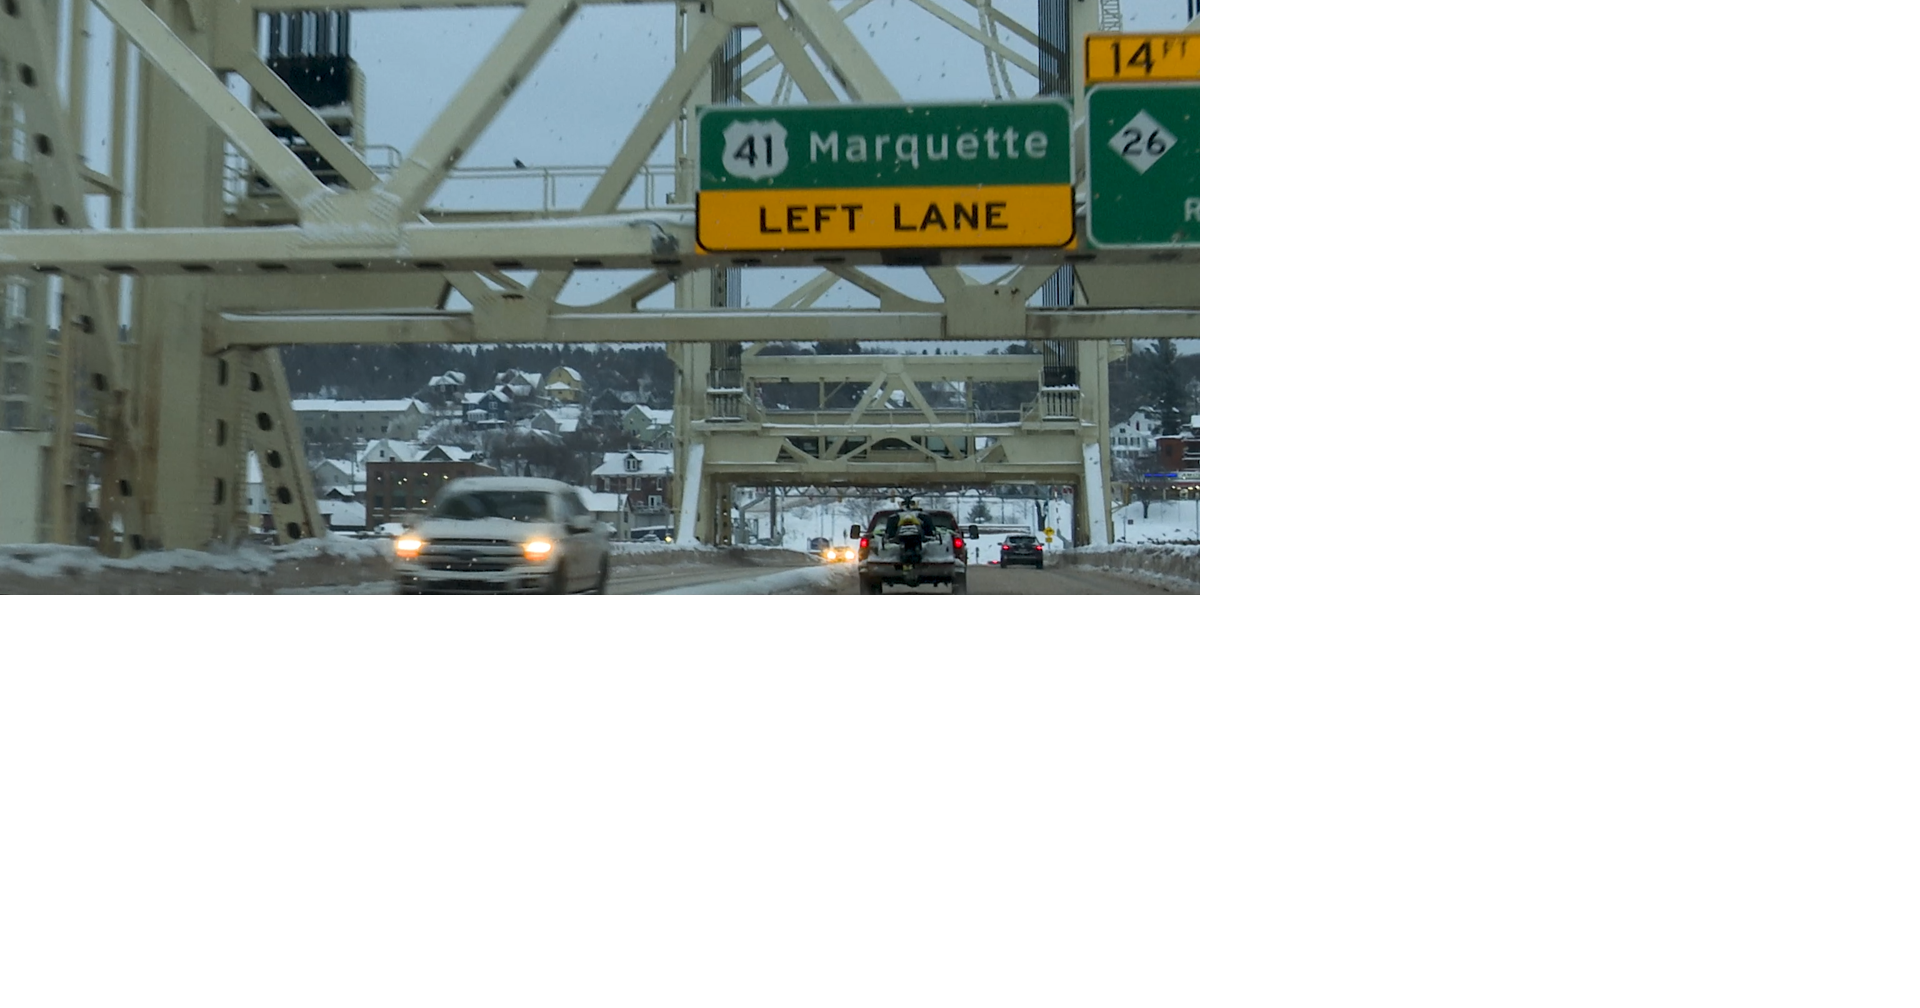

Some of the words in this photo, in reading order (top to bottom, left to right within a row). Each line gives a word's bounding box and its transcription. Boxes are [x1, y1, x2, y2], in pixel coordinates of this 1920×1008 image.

[1111, 42, 1154, 76] 14
[733, 134, 773, 167] 41
[809, 126, 1048, 170] Marquette
[1121, 127, 1167, 156] 26
[760, 203, 863, 233] LEFT
[894, 202, 1008, 231] LANE
